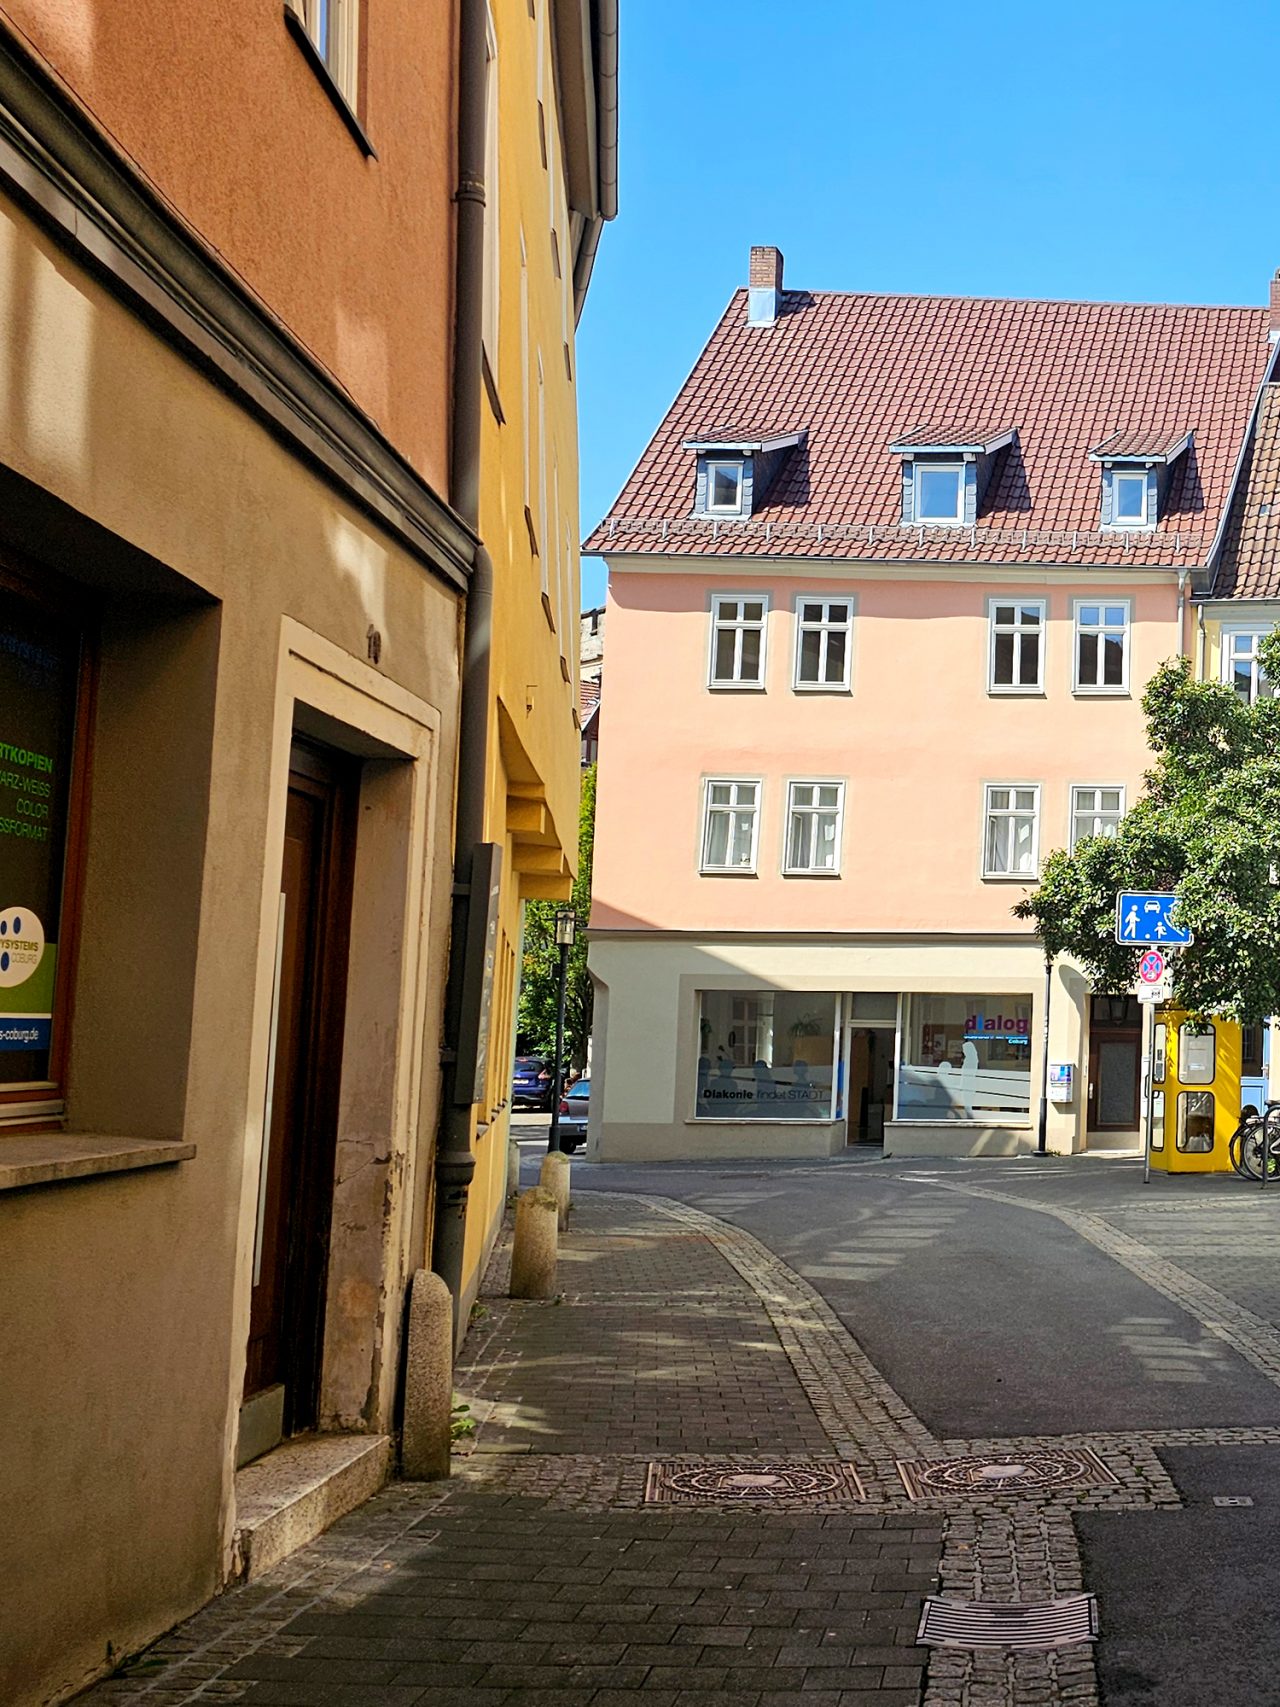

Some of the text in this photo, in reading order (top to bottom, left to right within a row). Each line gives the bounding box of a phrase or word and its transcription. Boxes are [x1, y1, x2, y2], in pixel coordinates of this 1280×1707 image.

[0, 770, 51, 798] ARZ-WEISS
[16, 798, 49, 818] COLOR
[12, 952, 38, 964] COBURG
[965, 1012, 1028, 1034] dialog
[703, 1088, 754, 1100] Diakonie
[788, 1089, 824, 1100] STADT
